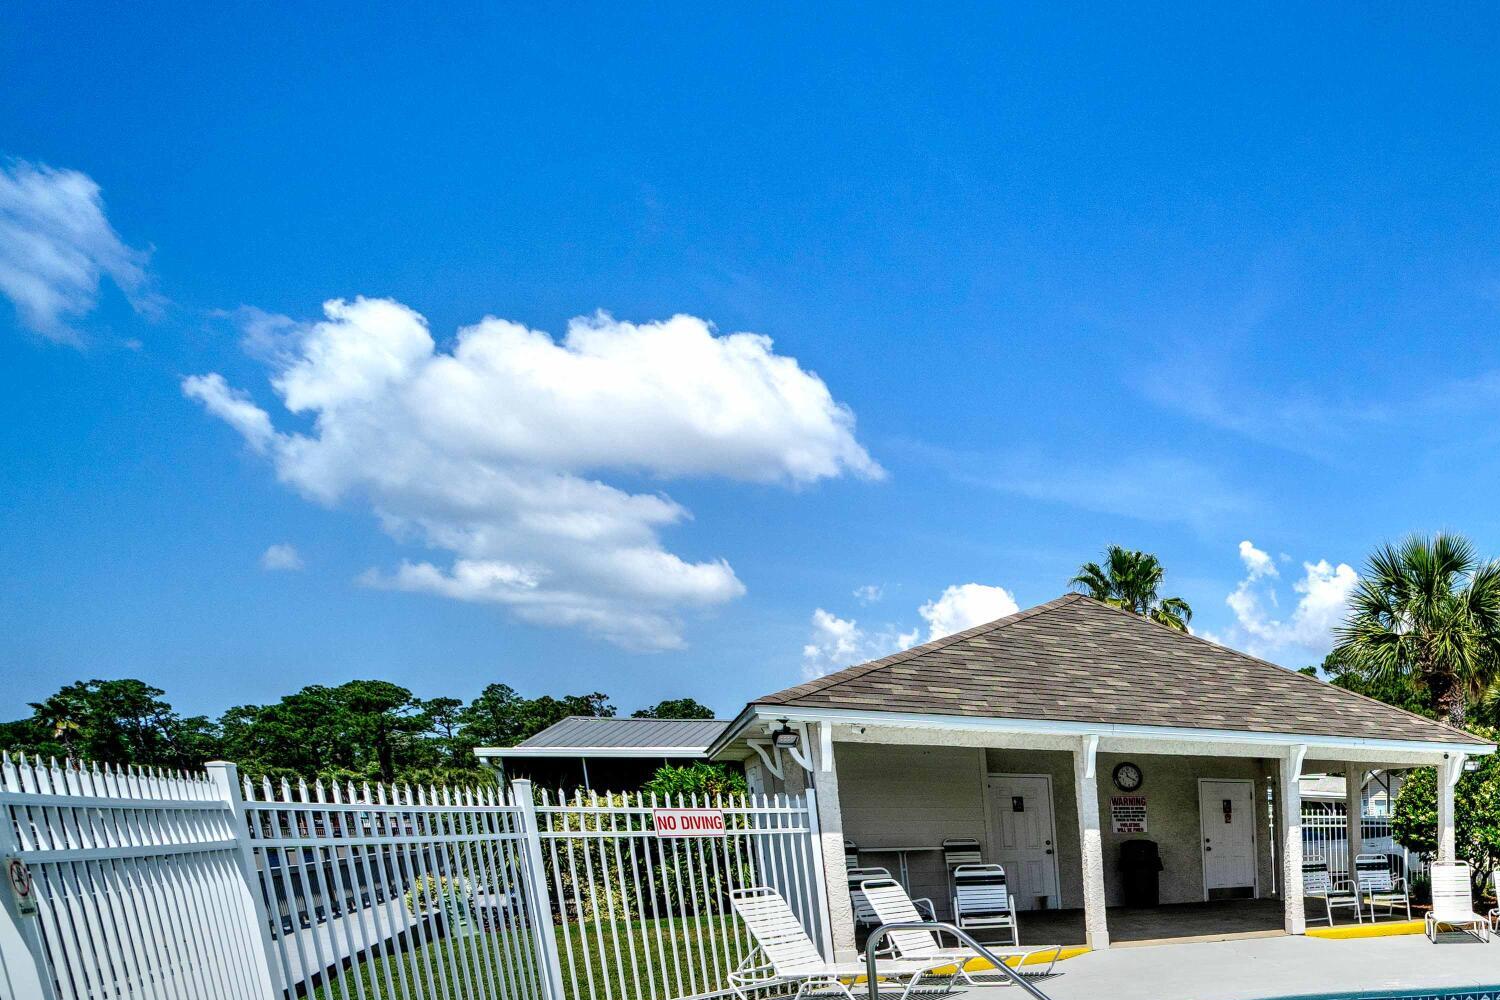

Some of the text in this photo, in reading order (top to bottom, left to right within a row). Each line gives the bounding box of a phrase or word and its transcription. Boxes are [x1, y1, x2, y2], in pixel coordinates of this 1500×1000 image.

[1111, 797, 1146, 806] WARNING
[657, 816, 723, 830] NO DIVING
